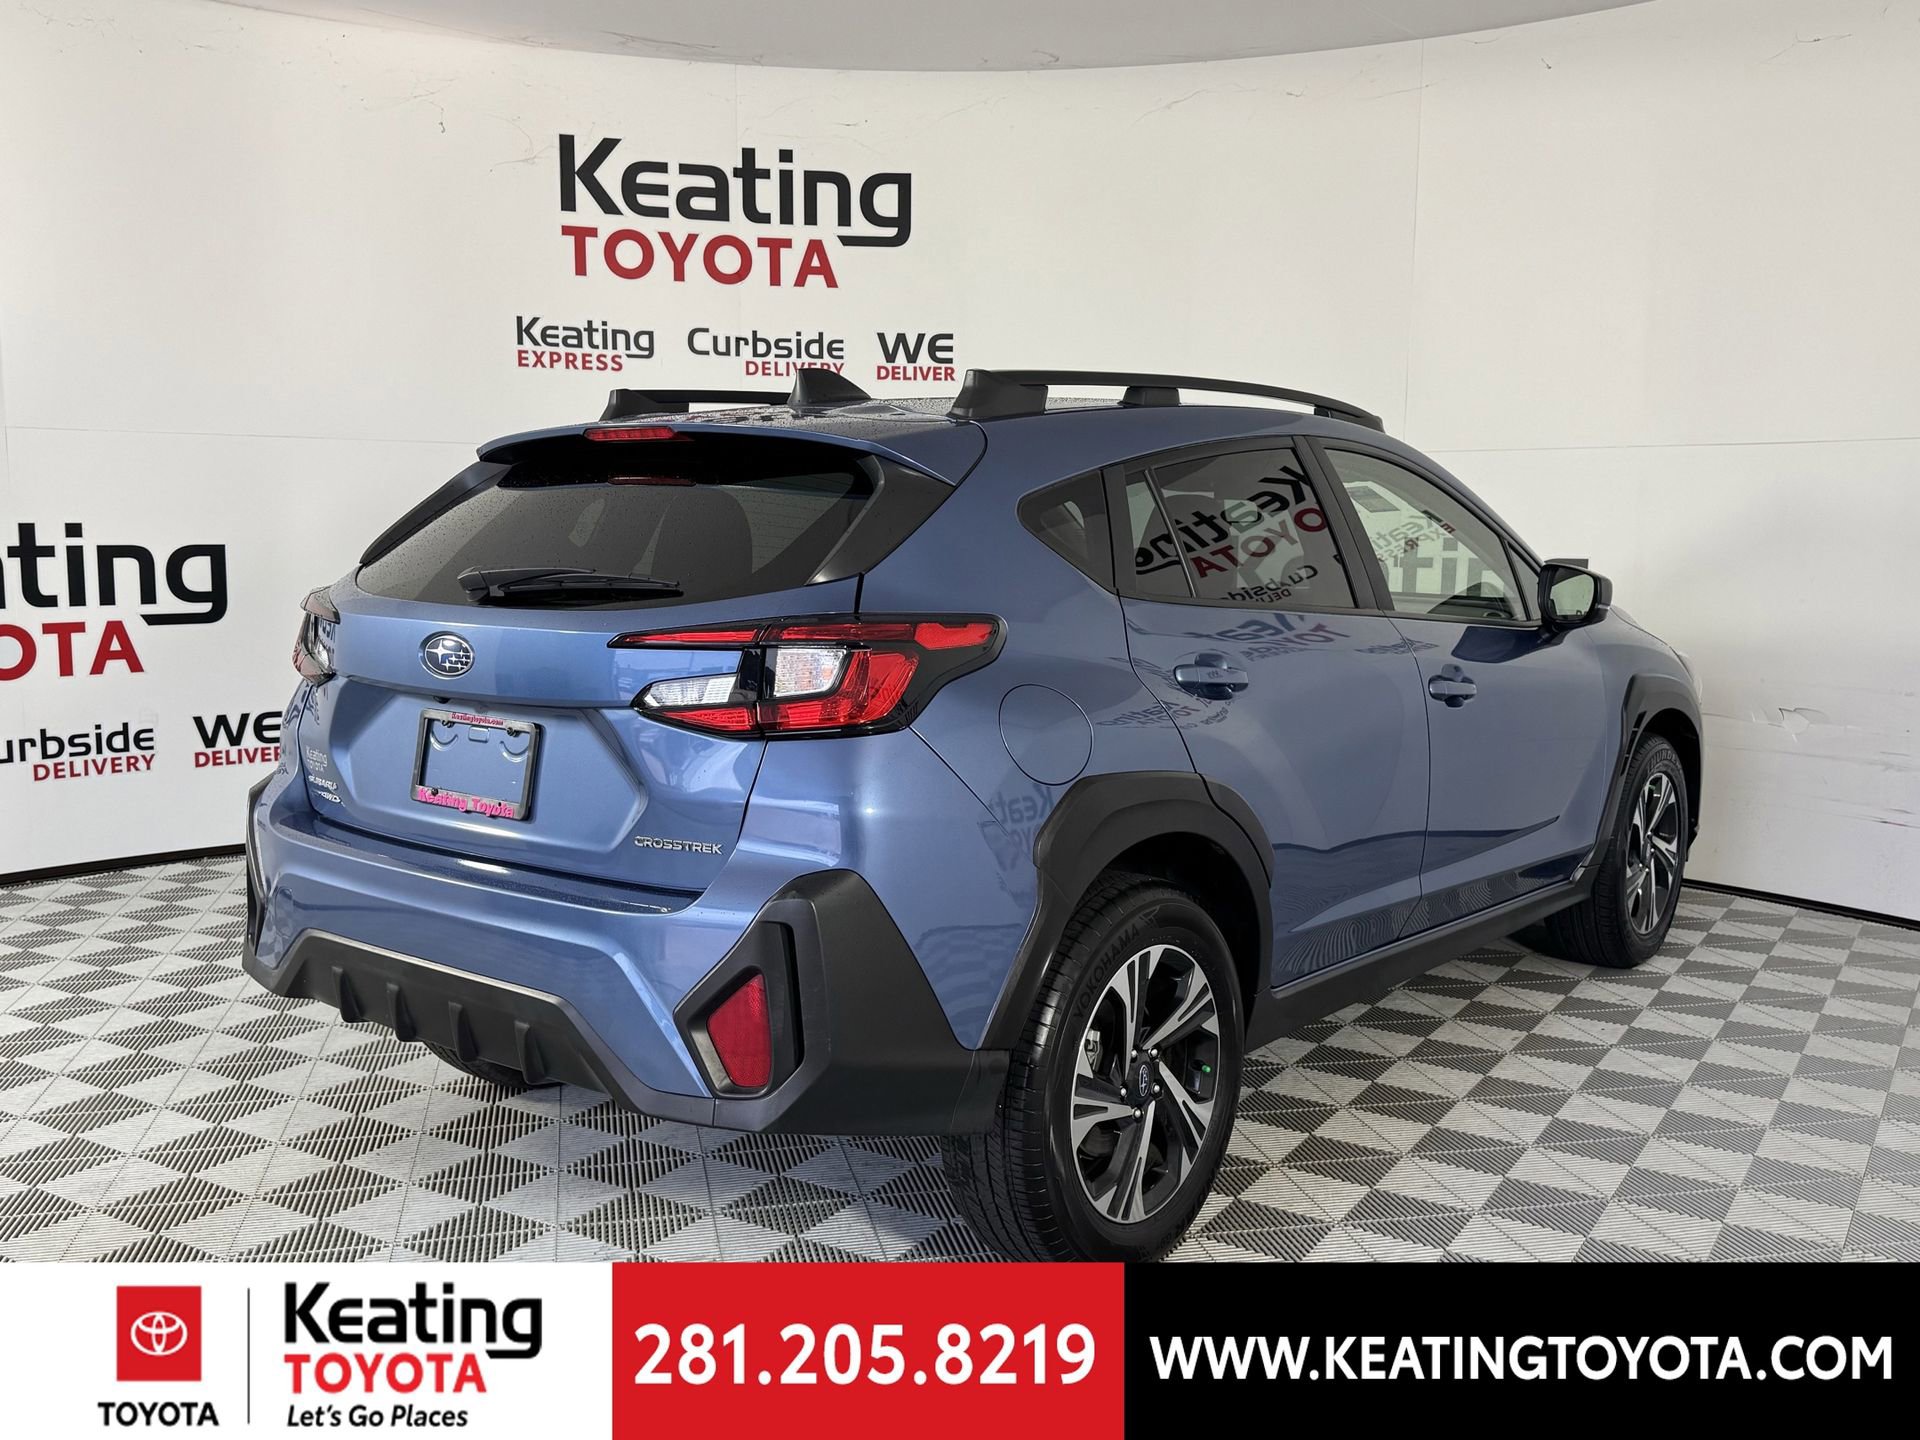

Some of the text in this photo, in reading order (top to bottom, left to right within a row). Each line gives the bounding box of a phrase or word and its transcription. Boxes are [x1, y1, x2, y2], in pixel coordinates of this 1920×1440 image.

[559, 134, 912, 248] Keating
[561, 225, 839, 288] TOYOTA
[516, 315, 655, 360] Keating
[687, 327, 845, 360] Curbside
[876, 332, 955, 365] WE
[517, 349, 624, 372] EXPRESS
[876, 365, 956, 382] DELIVER
[0, 522, 228, 626] ting
[192, 710, 284, 749] WE
[33, 753, 156, 781] DELIVERY
[417, 787, 516, 818] Keating Toyota
[634, 835, 723, 855] CROSSTREK
[1073, 924, 1140, 1018] YOKOHAMA
